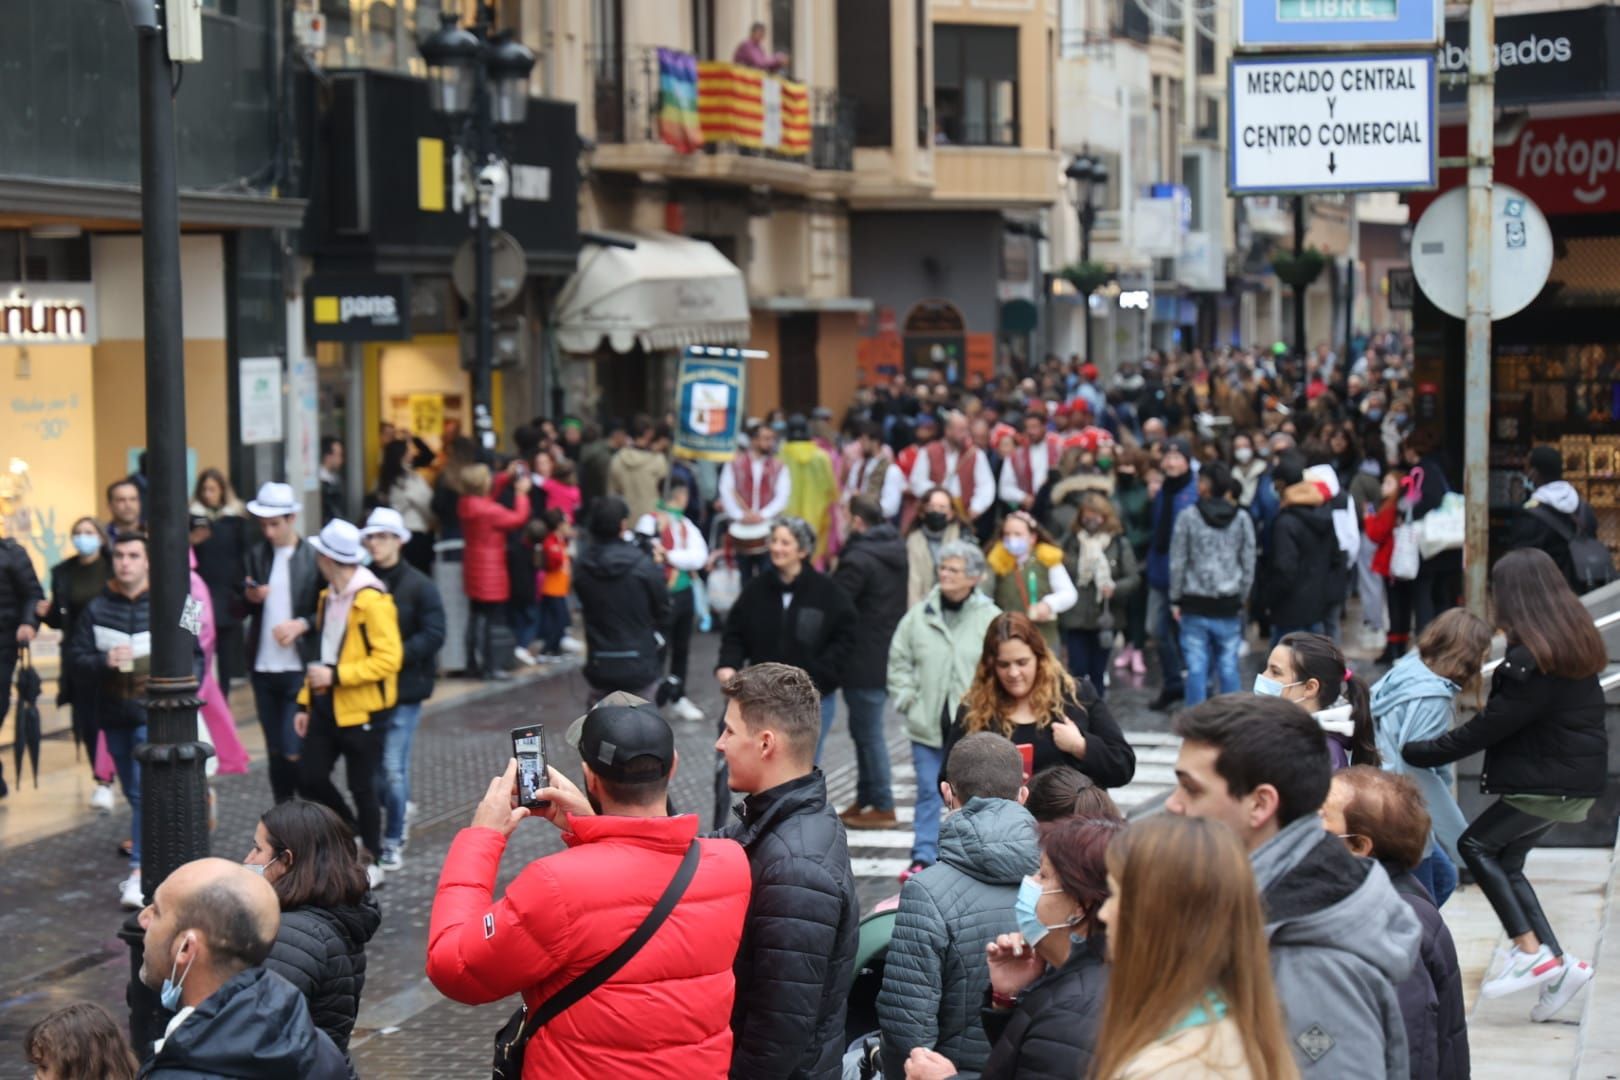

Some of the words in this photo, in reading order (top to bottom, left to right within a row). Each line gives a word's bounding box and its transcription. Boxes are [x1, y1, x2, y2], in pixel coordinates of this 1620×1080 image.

[1247, 70, 1334, 94] MERCADO
[1341, 67, 1416, 91] CENTRAL
[1327, 96, 1337, 119] Y
[1243, 124, 1312, 148] CENTRO
[1318, 121, 1421, 146] COMERCIAL
[1517, 130, 1620, 186] fotop
